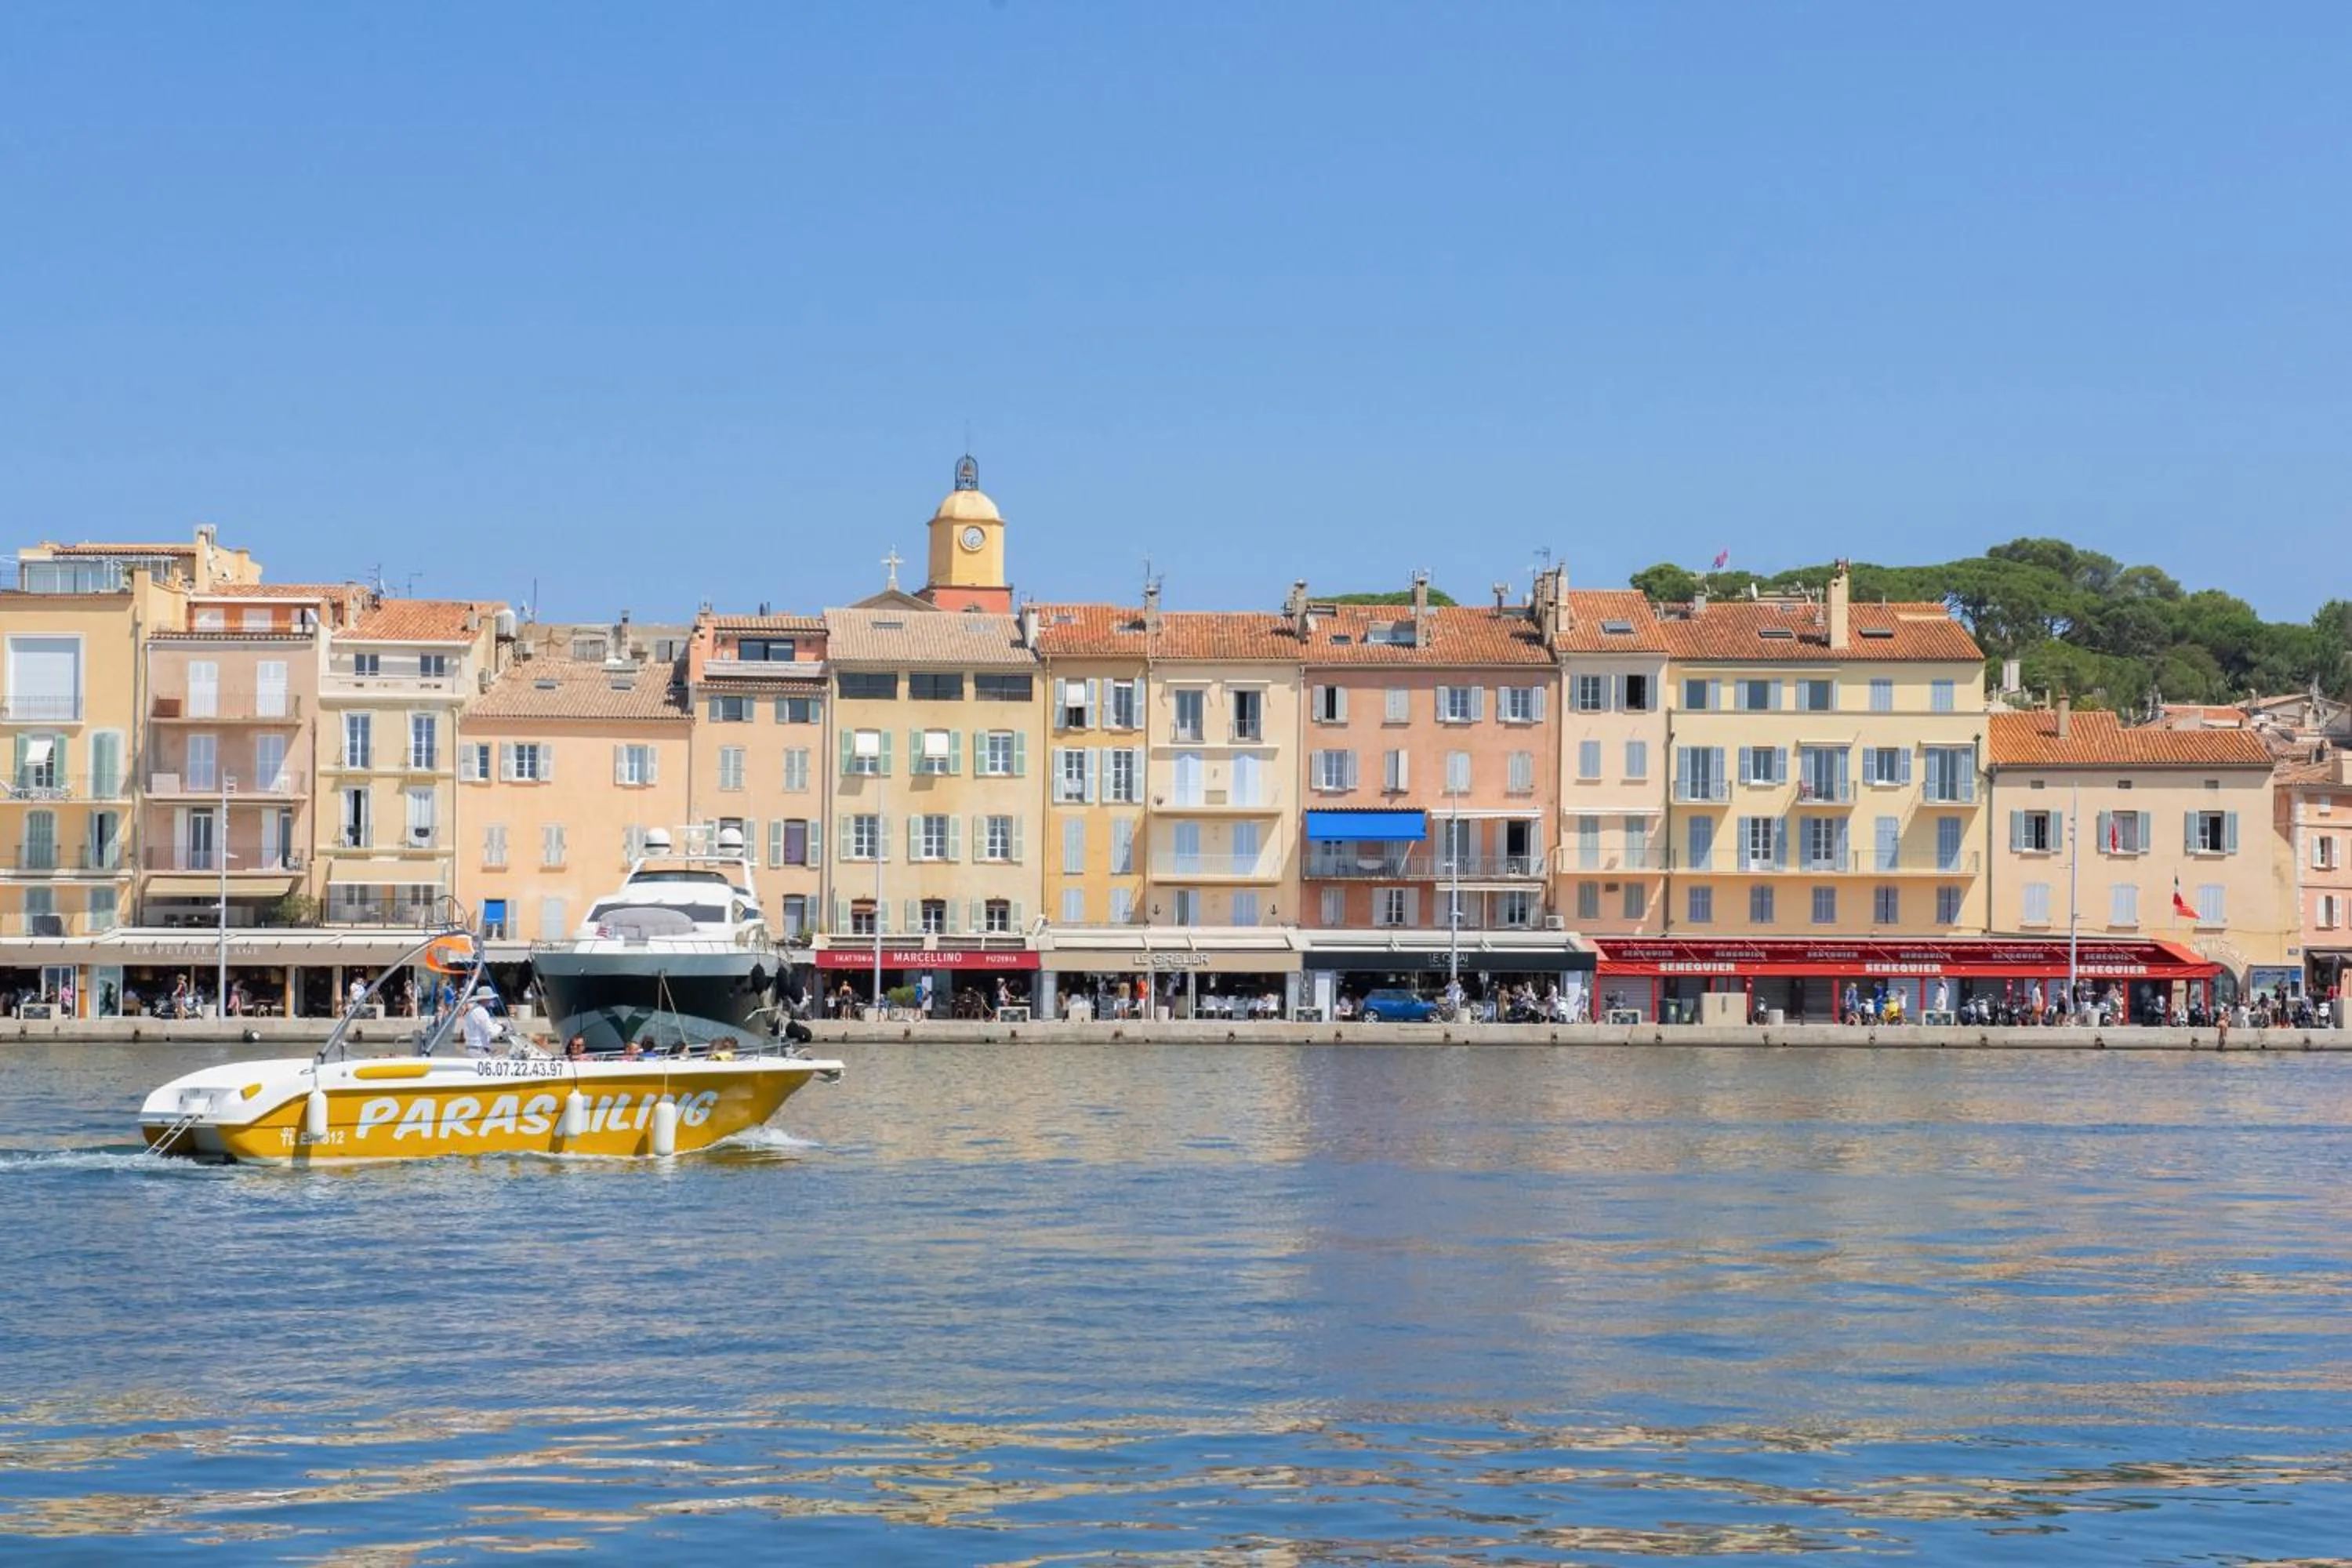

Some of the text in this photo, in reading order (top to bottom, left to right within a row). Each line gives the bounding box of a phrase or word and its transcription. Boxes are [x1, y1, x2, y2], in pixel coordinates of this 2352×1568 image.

[216, 945, 262, 955] AGE
[893, 953, 963, 963] MARCELLINO
[1442, 953, 1468, 964] QAI
[1658, 962, 1736, 972] SENEQUIER
[1865, 963, 1942, 973] SENEQUIER
[477, 1061, 564, 1077] 06.07.22.43.97
